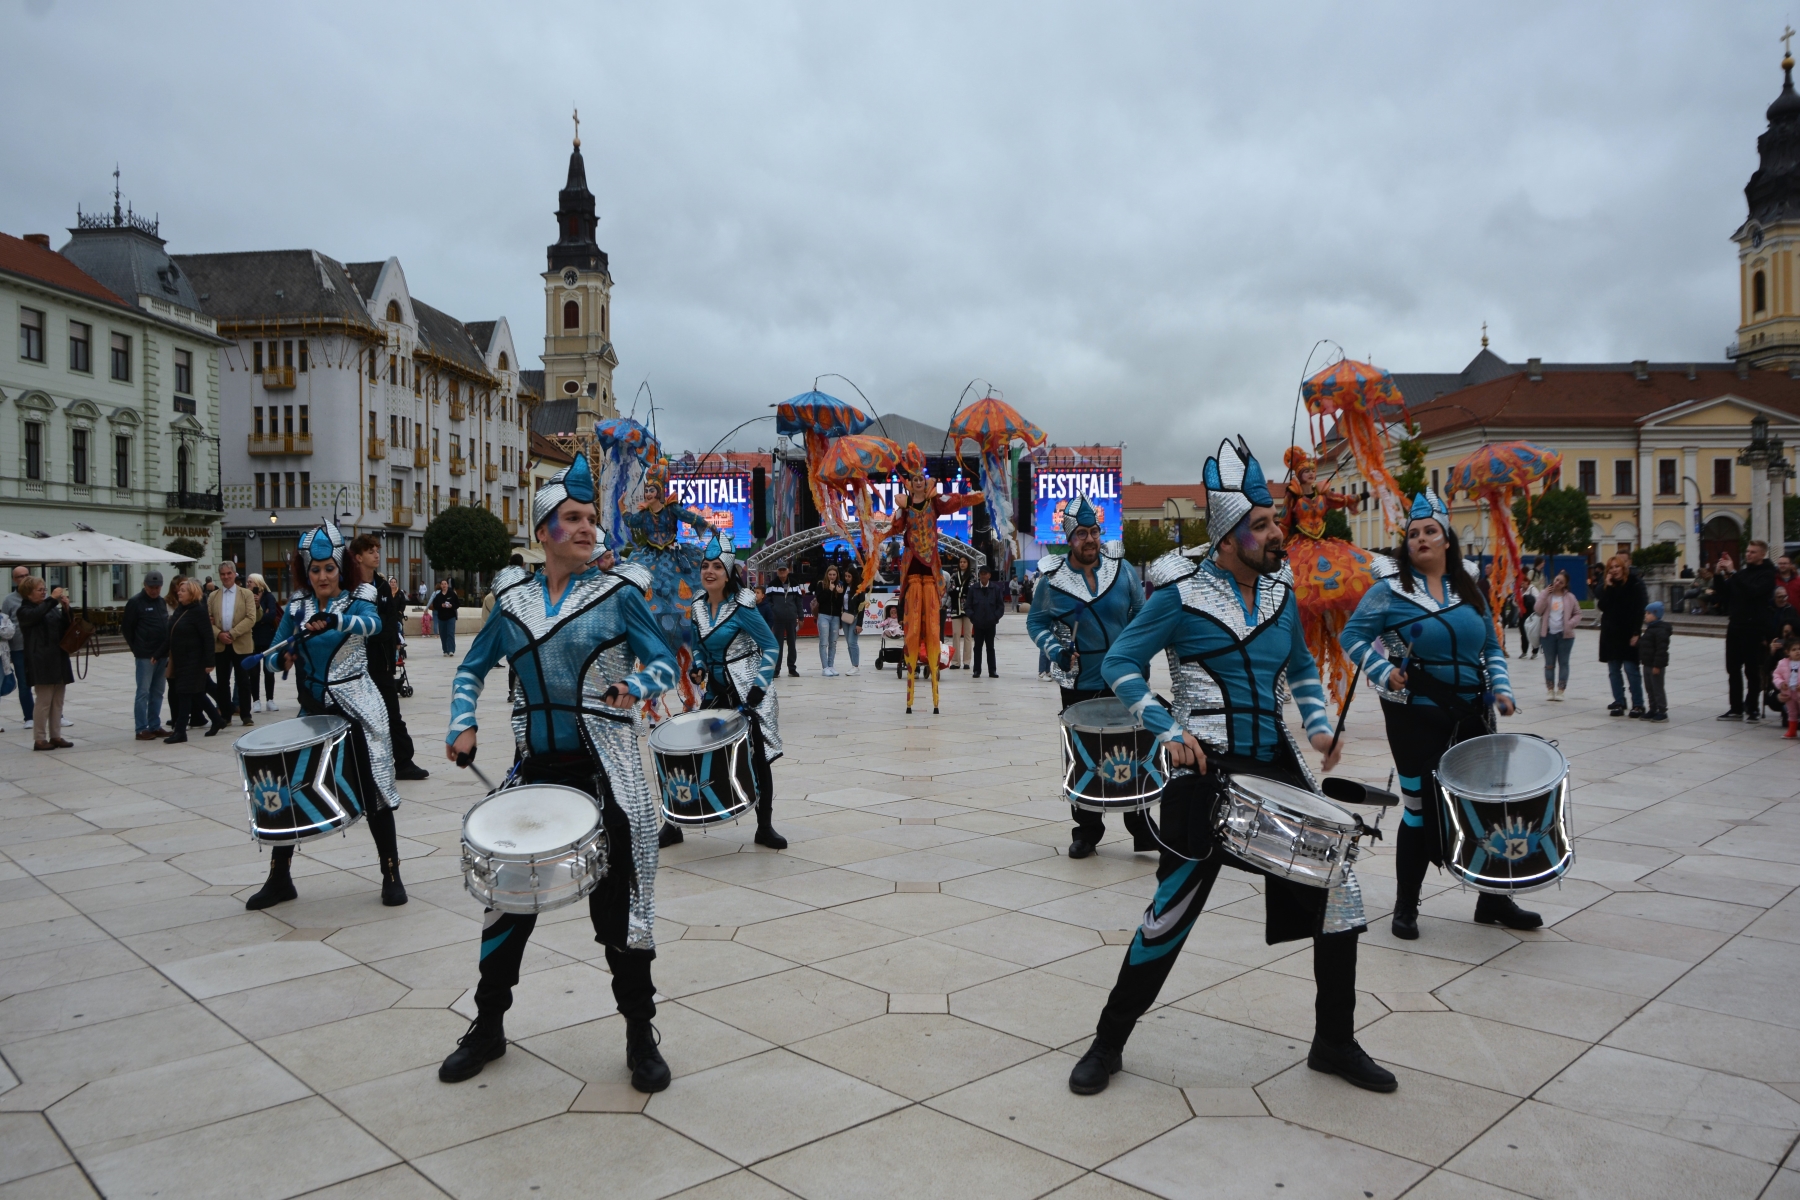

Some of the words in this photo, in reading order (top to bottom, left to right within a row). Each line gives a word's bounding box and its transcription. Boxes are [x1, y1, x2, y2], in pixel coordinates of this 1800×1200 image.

[1038, 473, 1118, 499] FESTIFALL
[162, 526, 188, 537] ALPHA
[189, 527, 211, 538] BANK
